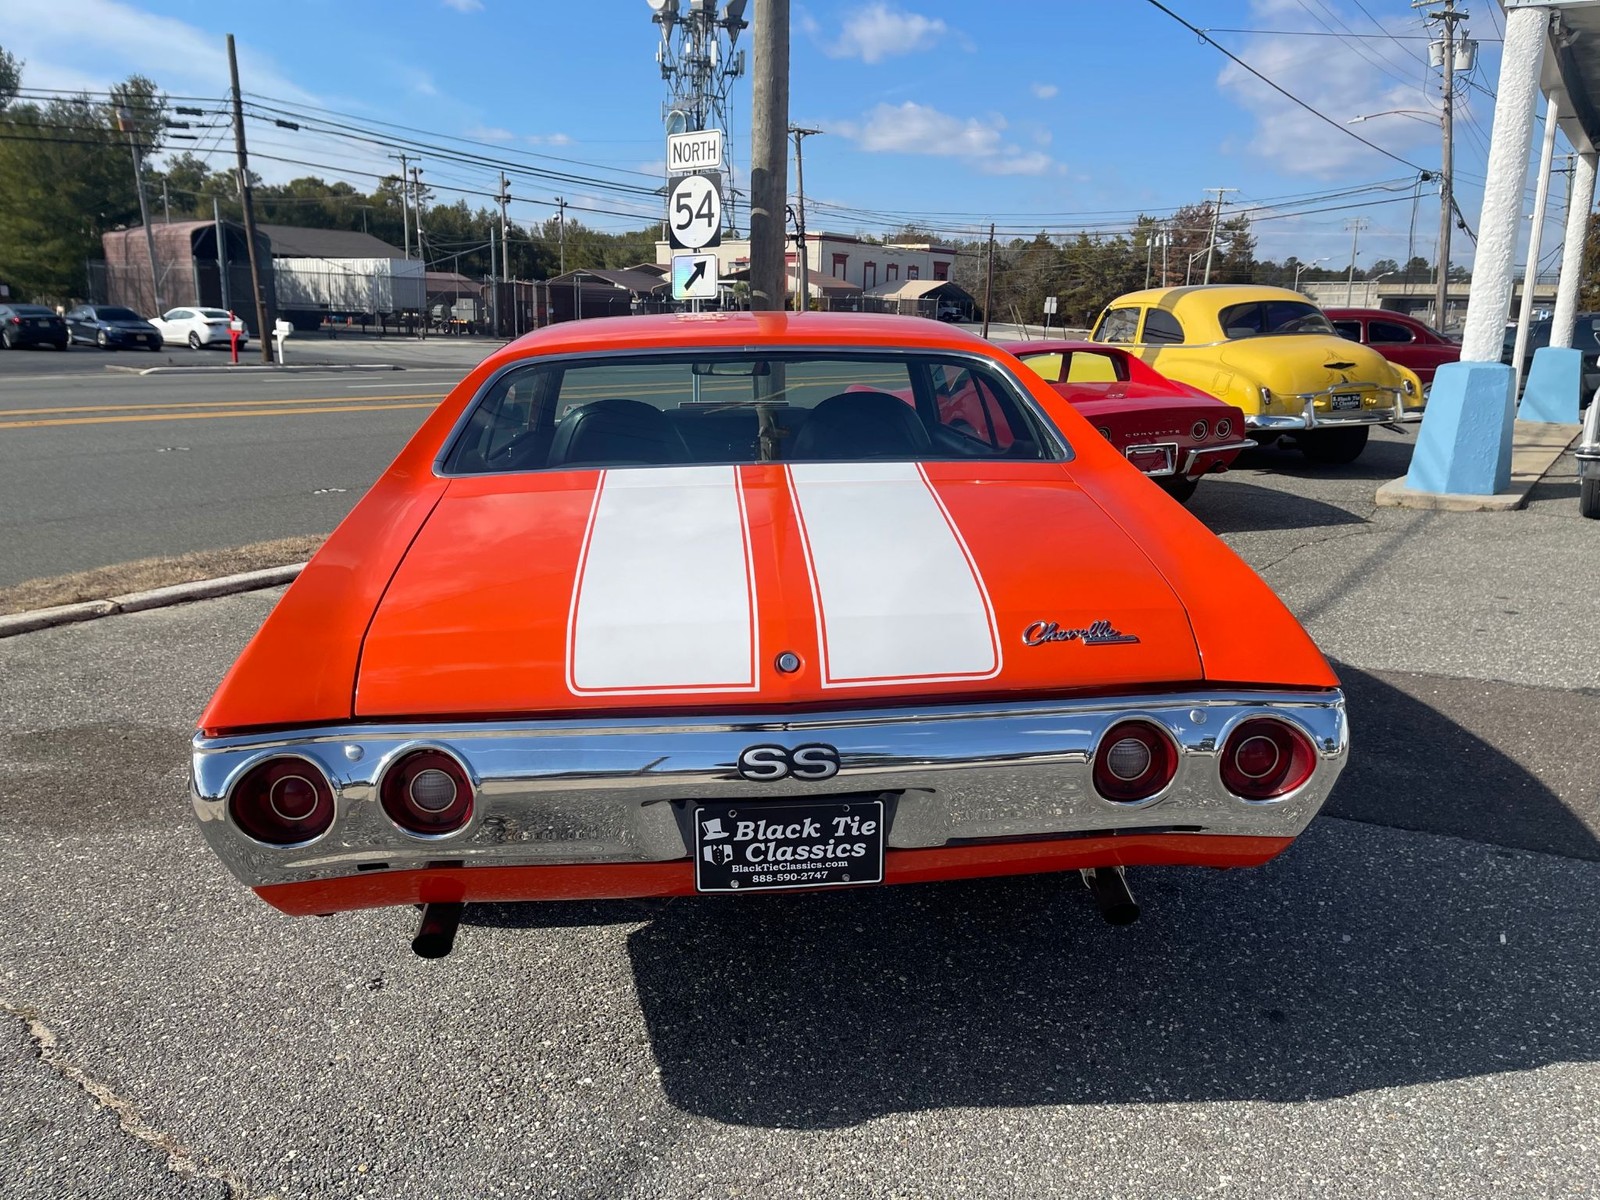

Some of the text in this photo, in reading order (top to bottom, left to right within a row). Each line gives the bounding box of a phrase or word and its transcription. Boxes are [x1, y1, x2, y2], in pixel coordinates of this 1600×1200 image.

[673, 140, 716, 164] NORTH
[676, 190, 714, 230] 54
[1022, 620, 1121, 646] Chevelle
[743, 747, 838, 779] SS
[733, 815, 877, 841] Black Tie
[745, 839, 867, 862] Classics
[732, 860, 848, 873] BlackTieClassics.com
[752, 871, 828, 883] 888-590-2747
